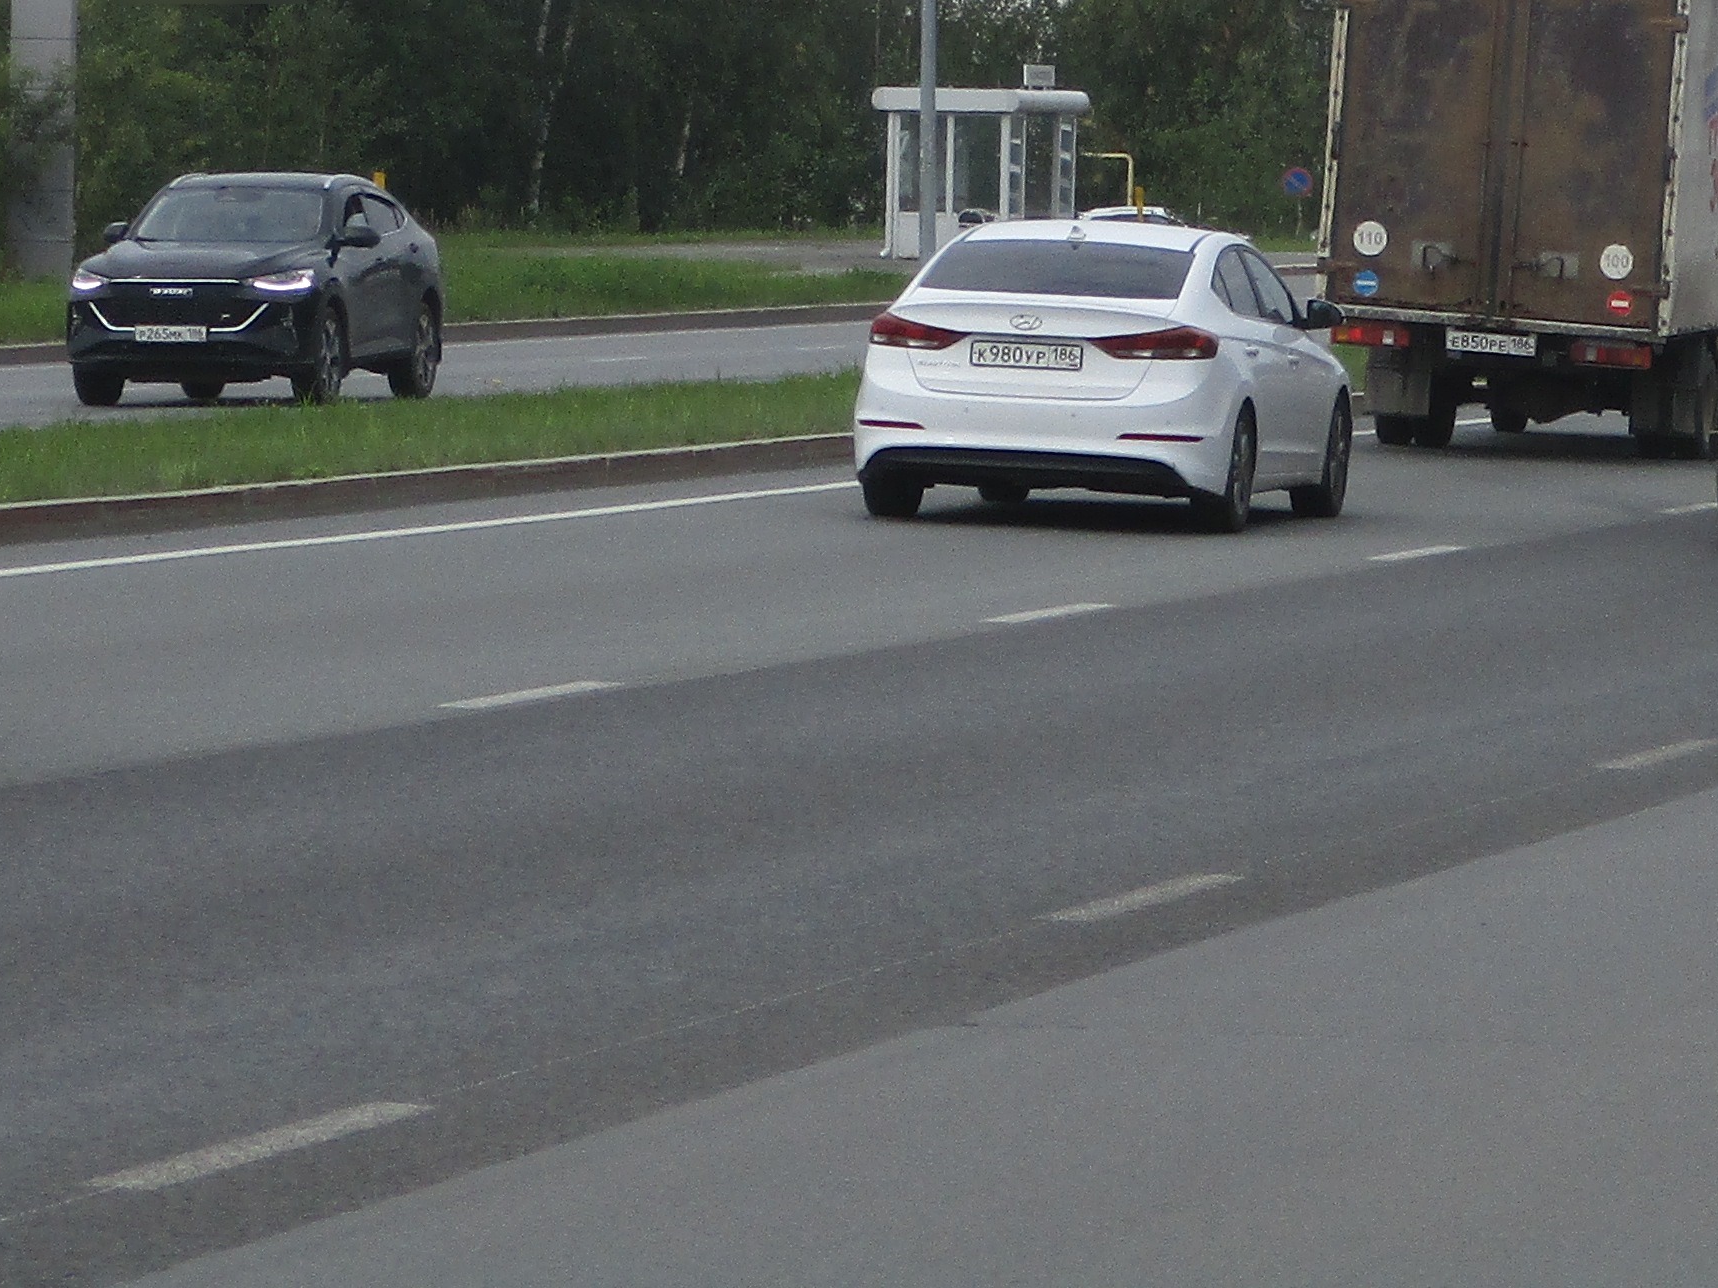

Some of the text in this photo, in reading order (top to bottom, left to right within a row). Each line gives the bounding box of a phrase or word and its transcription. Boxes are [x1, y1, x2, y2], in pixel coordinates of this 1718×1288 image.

[1357, 230, 1383, 246] 110
[1606, 253, 1630, 269] 100
[1451, 332, 1507, 352] Е850РЕ
[977, 345, 1077, 365] К980УР 186
